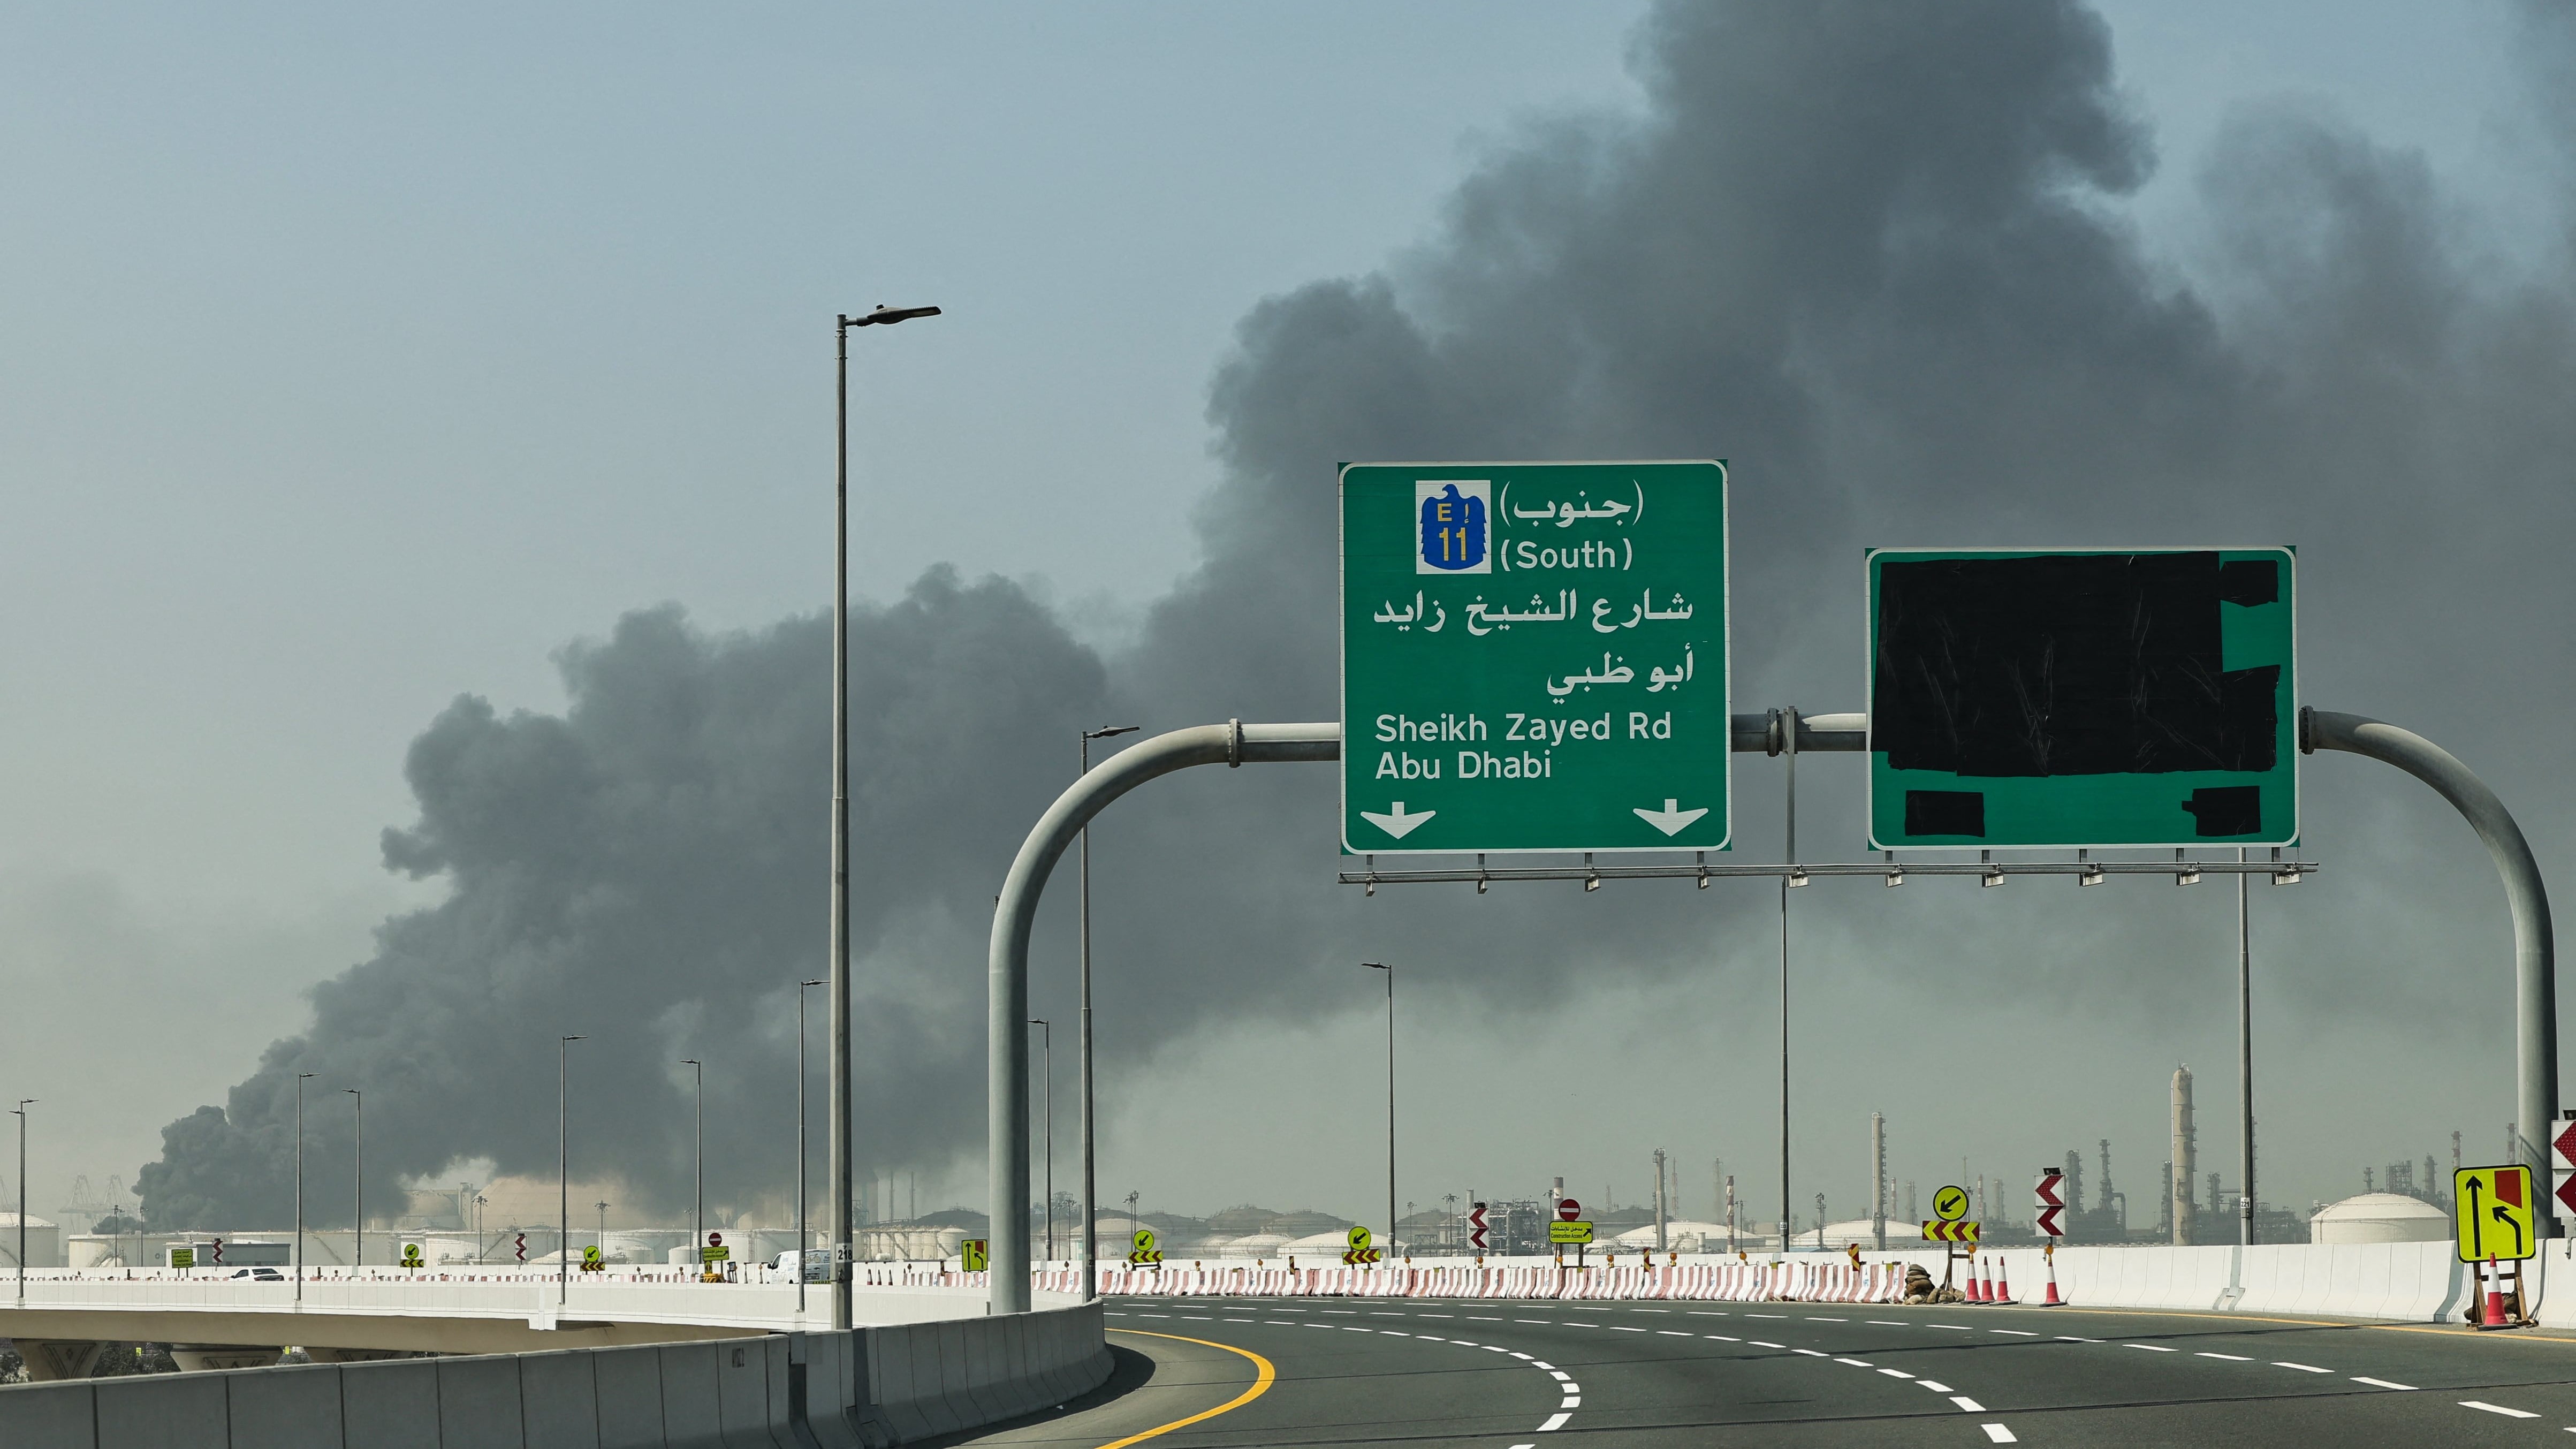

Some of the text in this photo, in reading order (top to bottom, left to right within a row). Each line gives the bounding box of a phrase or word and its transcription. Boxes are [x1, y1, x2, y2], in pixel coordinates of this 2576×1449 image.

[1438, 503, 1452, 521] E
[1500, 480, 1643, 528] (جنوب)
[1439, 527, 1466, 561] 11
[1501, 538, 1632, 572] (South)
[1374, 587, 1693, 636] شارع الشيخ زايد
[1547, 642, 1693, 704] أبو ظبي
[1375, 711, 1670, 746] Sheikh Zayed Rd
[1376, 749, 1551, 779] Abu Dhabi
[838, 1249, 852, 1260] 218
